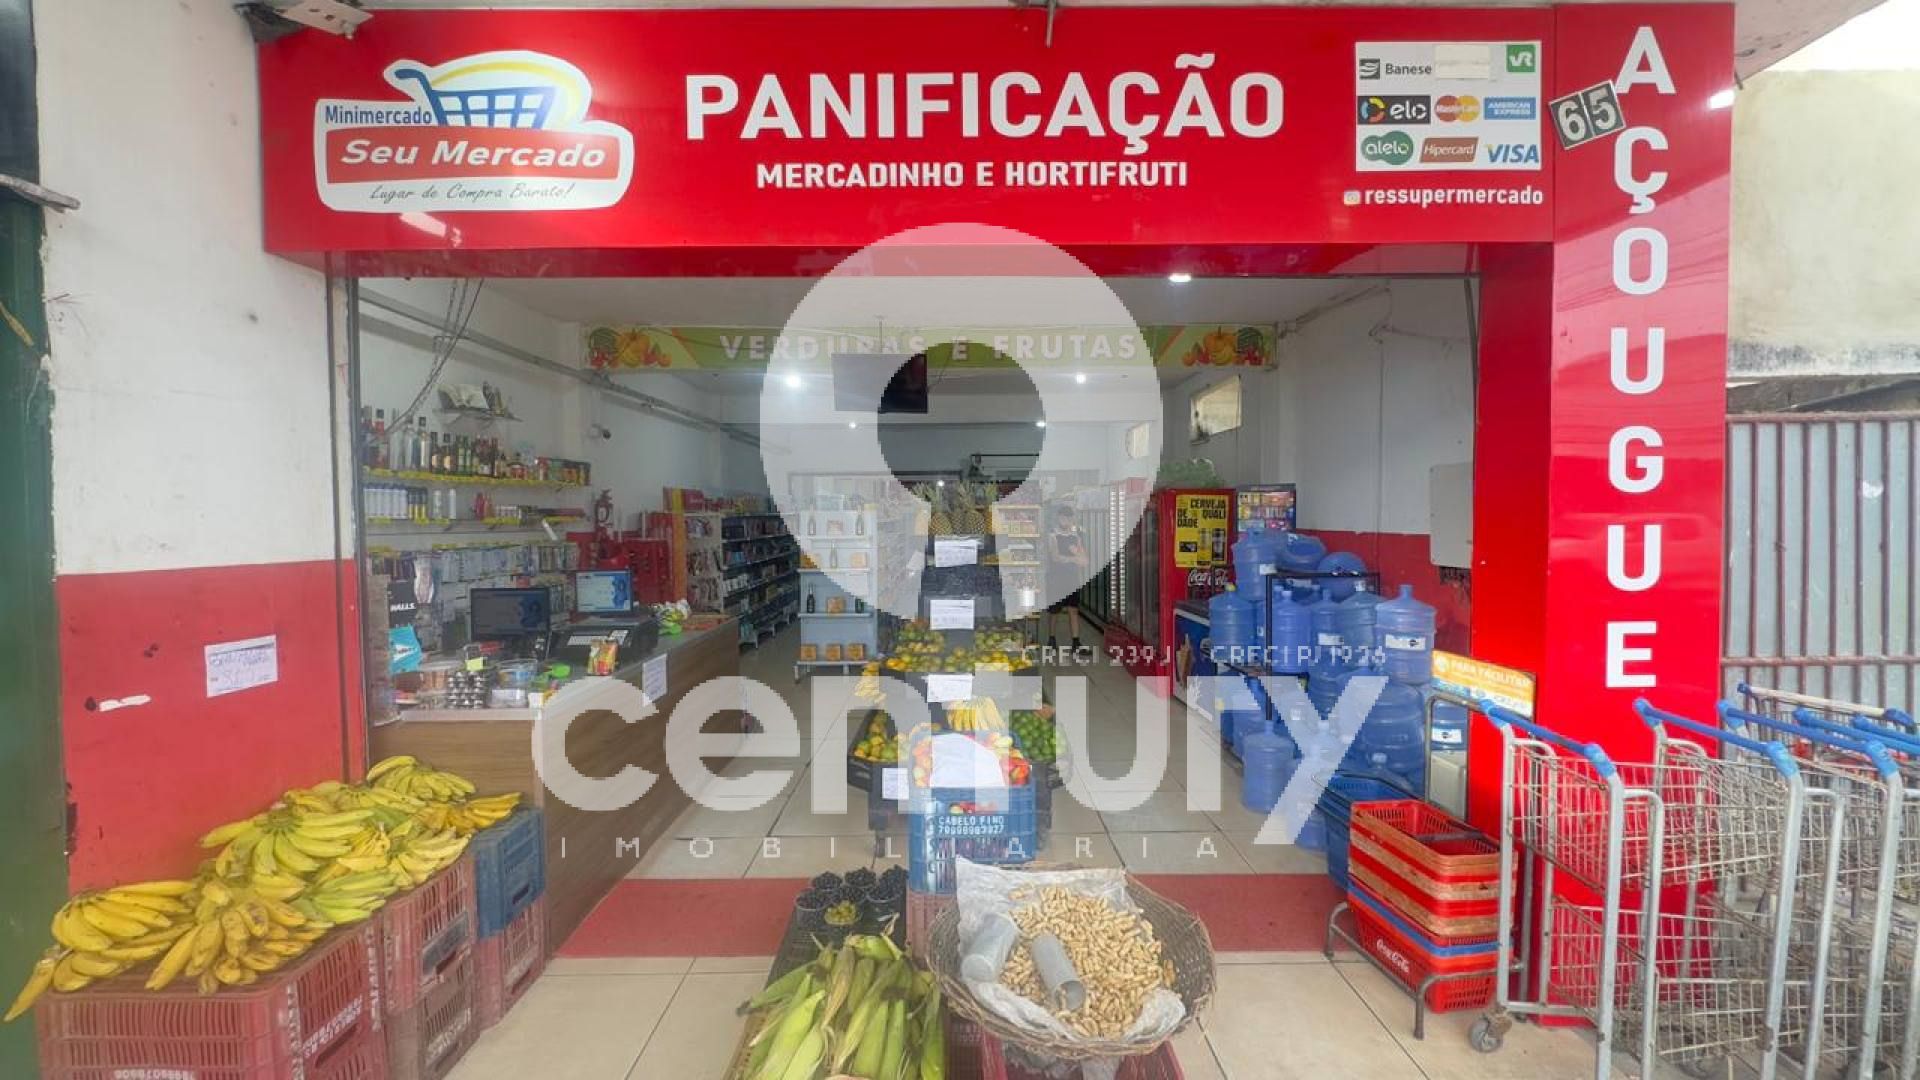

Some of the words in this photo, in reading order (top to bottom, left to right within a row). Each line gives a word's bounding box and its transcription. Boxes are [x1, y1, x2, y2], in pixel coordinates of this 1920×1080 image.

[1385, 63, 1432, 75] Banese
[685, 53, 1284, 155] PANIFICAÇÃO
[1390, 101, 1427, 120] elo
[1494, 108, 1531, 116] EXPRESS
[325, 105, 432, 124] Minimercado
[1557, 87, 1619, 142] 65
[341, 139, 418, 165] Seu
[432, 141, 604, 167] Mercado
[1366, 142, 1409, 155] alelo
[1424, 144, 1474, 157] Hipercard
[1487, 144, 1540, 163] VISA
[757, 162, 964, 188] MERCADINHO
[977, 162, 993, 187] E
[1006, 161, 1187, 187] HORTIFRUTI
[369, 185, 414, 203] Lugar
[421, 186, 438, 199] de
[446, 184, 502, 202] Compra
[510, 183, 575, 200] Barato!
[1365, 186, 1543, 208] ressupermercado
[720, 334, 926, 360] VERDURAS
[951, 338, 969, 360] E
[994, 334, 1136, 360] FRUTAS
[1605, 26, 1675, 689] AÇOUGUE
[1190, 499, 1226, 509] CERVEJA
